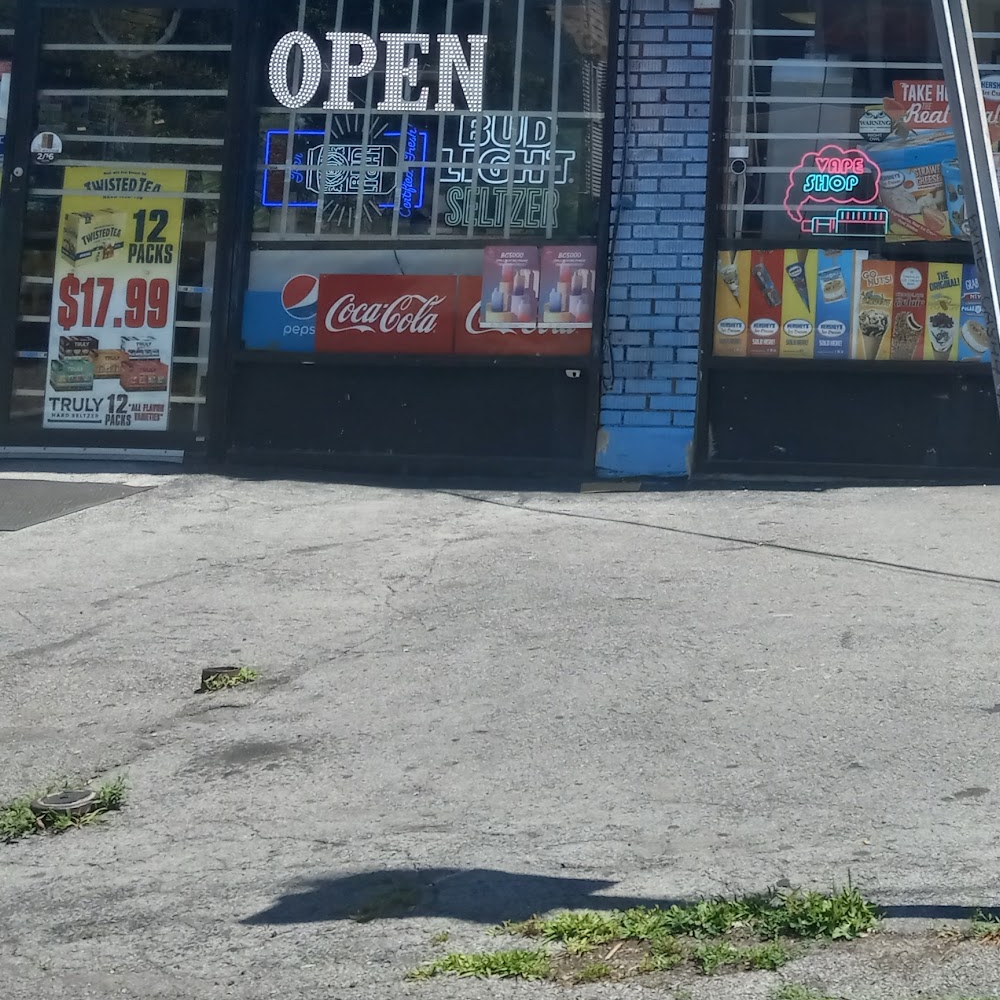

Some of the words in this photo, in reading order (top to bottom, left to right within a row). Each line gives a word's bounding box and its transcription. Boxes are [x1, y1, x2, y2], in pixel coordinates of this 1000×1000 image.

[268, 30, 488, 112] OPEN
[902, 83, 933, 102] TAKE
[903, 103, 949, 124] Real
[459, 114, 558, 148] BUD
[438, 148, 576, 185] LIGHT
[815, 157, 864, 174] VAPE
[83, 177, 137, 192] TWISTED
[138, 177, 162, 193] TEA
[803, 174, 859, 192] SHOP
[444, 186, 560, 229] SELTZER
[132, 208, 169, 243] 12
[128, 244, 173, 264] PACKS
[862, 270, 877, 280] GO
[867, 274, 893, 287] NUTS!
[57, 273, 170, 331] $17.99
[325, 293, 447, 334] Coca-Cola
[283, 324, 316, 336] peps
[49, 397, 104, 412] TRULY
[107, 394, 129, 414] 12
[105, 414, 131, 426] PACKS
